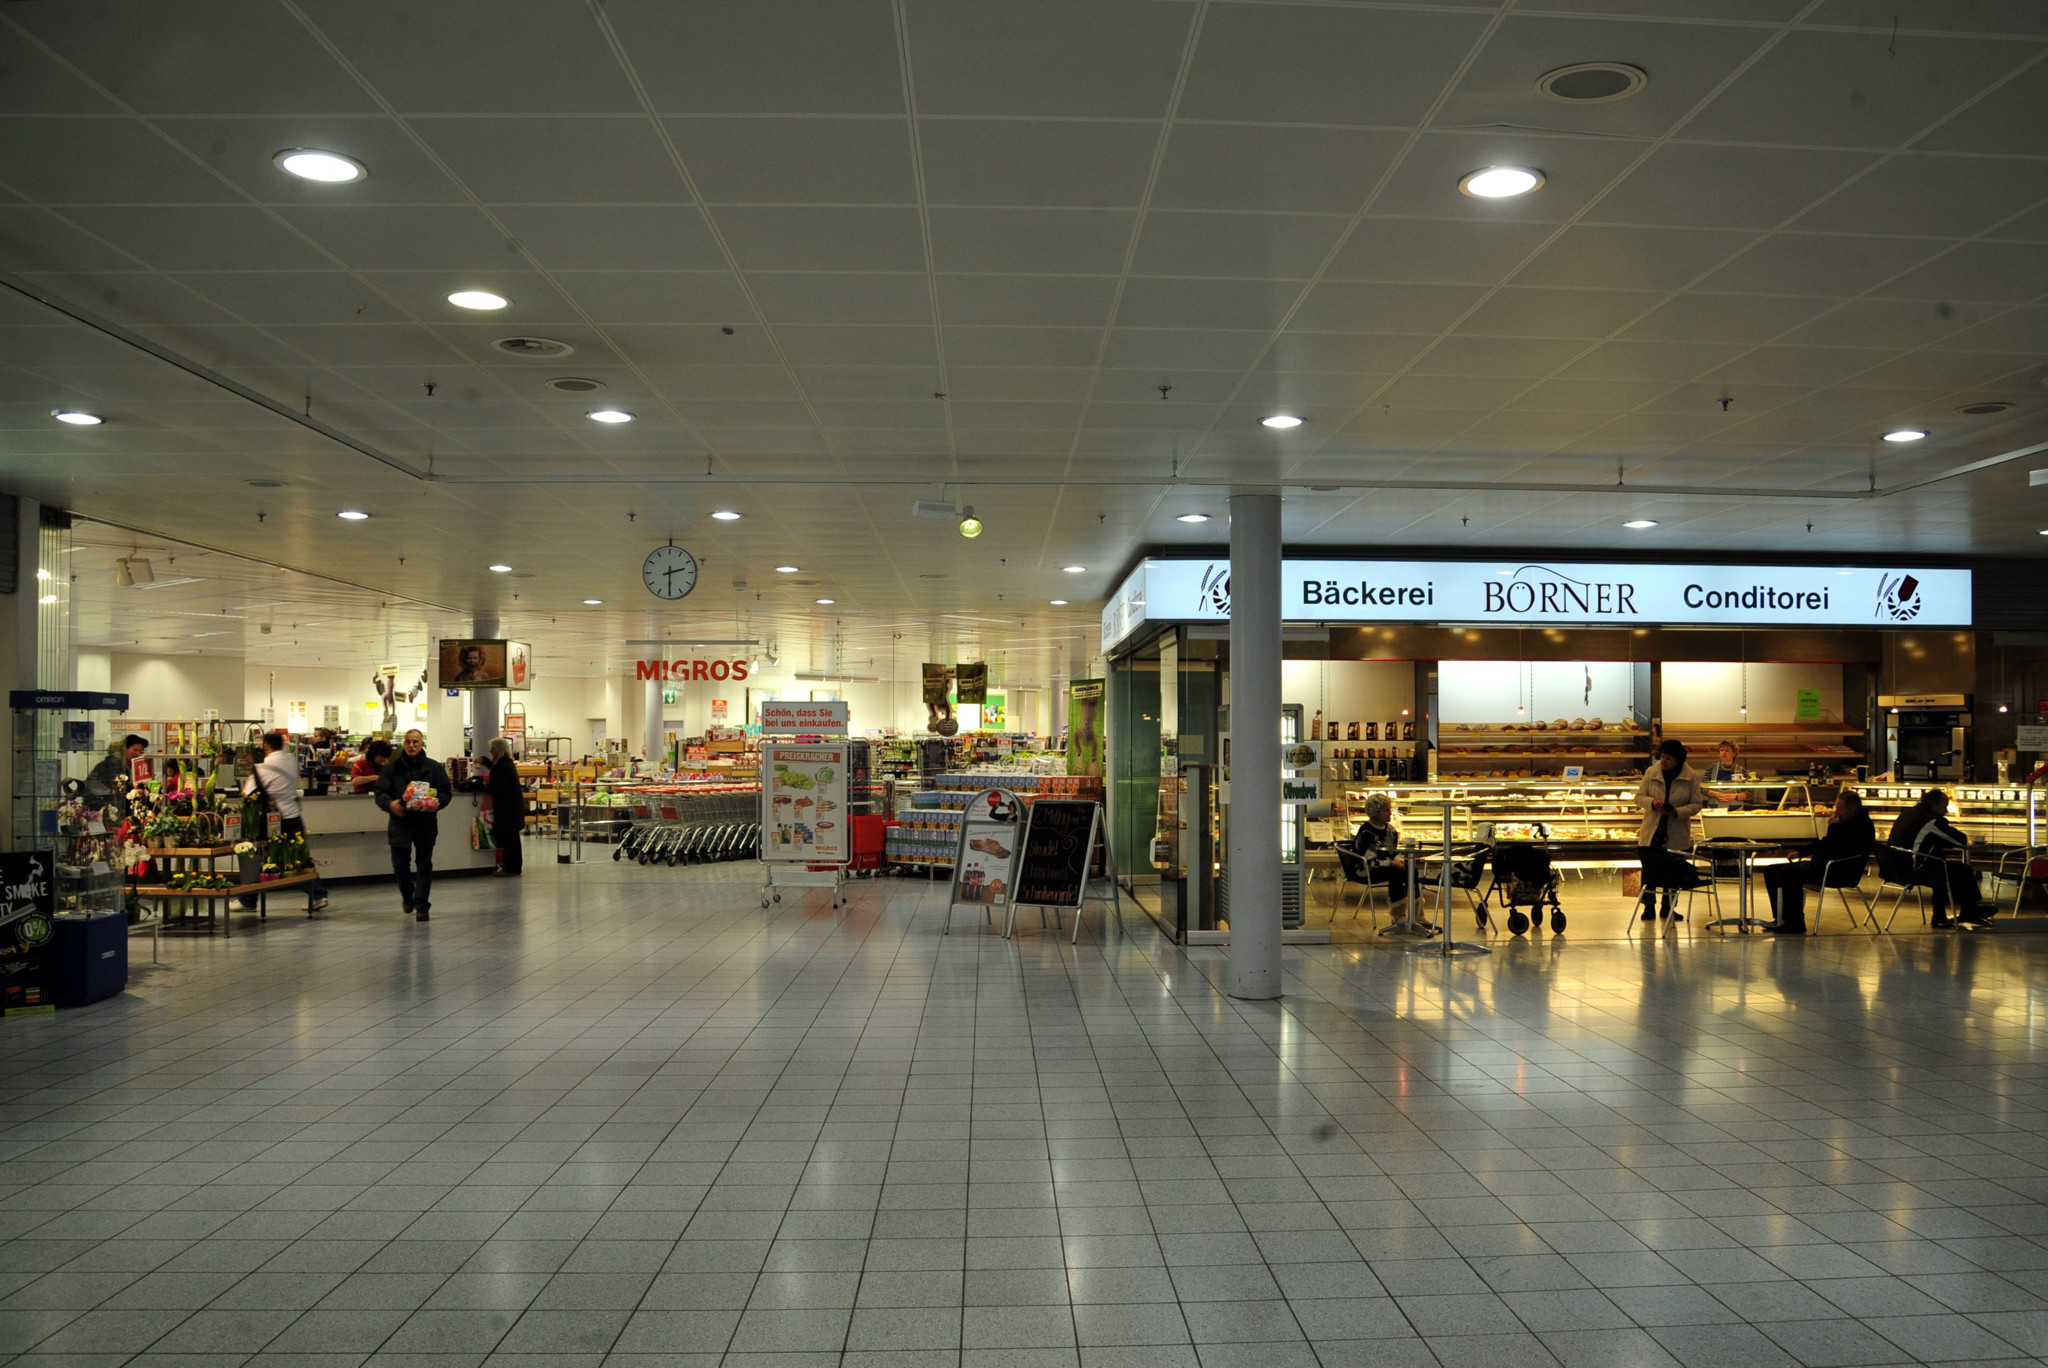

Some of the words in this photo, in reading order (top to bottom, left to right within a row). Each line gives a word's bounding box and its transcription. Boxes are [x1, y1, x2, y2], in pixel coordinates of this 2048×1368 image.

[1303, 580, 1433, 606] Bäckerei
[1483, 581, 1639, 614] BÖRNER
[1684, 583, 1830, 610] Conditorei
[636, 660, 748, 681] MIGROS
[765, 708, 794, 718] Schön,
[796, 708, 817, 717] dass
[819, 708, 833, 717] Sie
[765, 719, 778, 727] bei
[799, 719, 844, 727] einkaufen.
[780, 751, 834, 761] PREISKRACHER
[138, 763, 149, 777] 1/2
[5, 881, 48, 900] SMOKE
[24, 922, 46, 938] 0%
